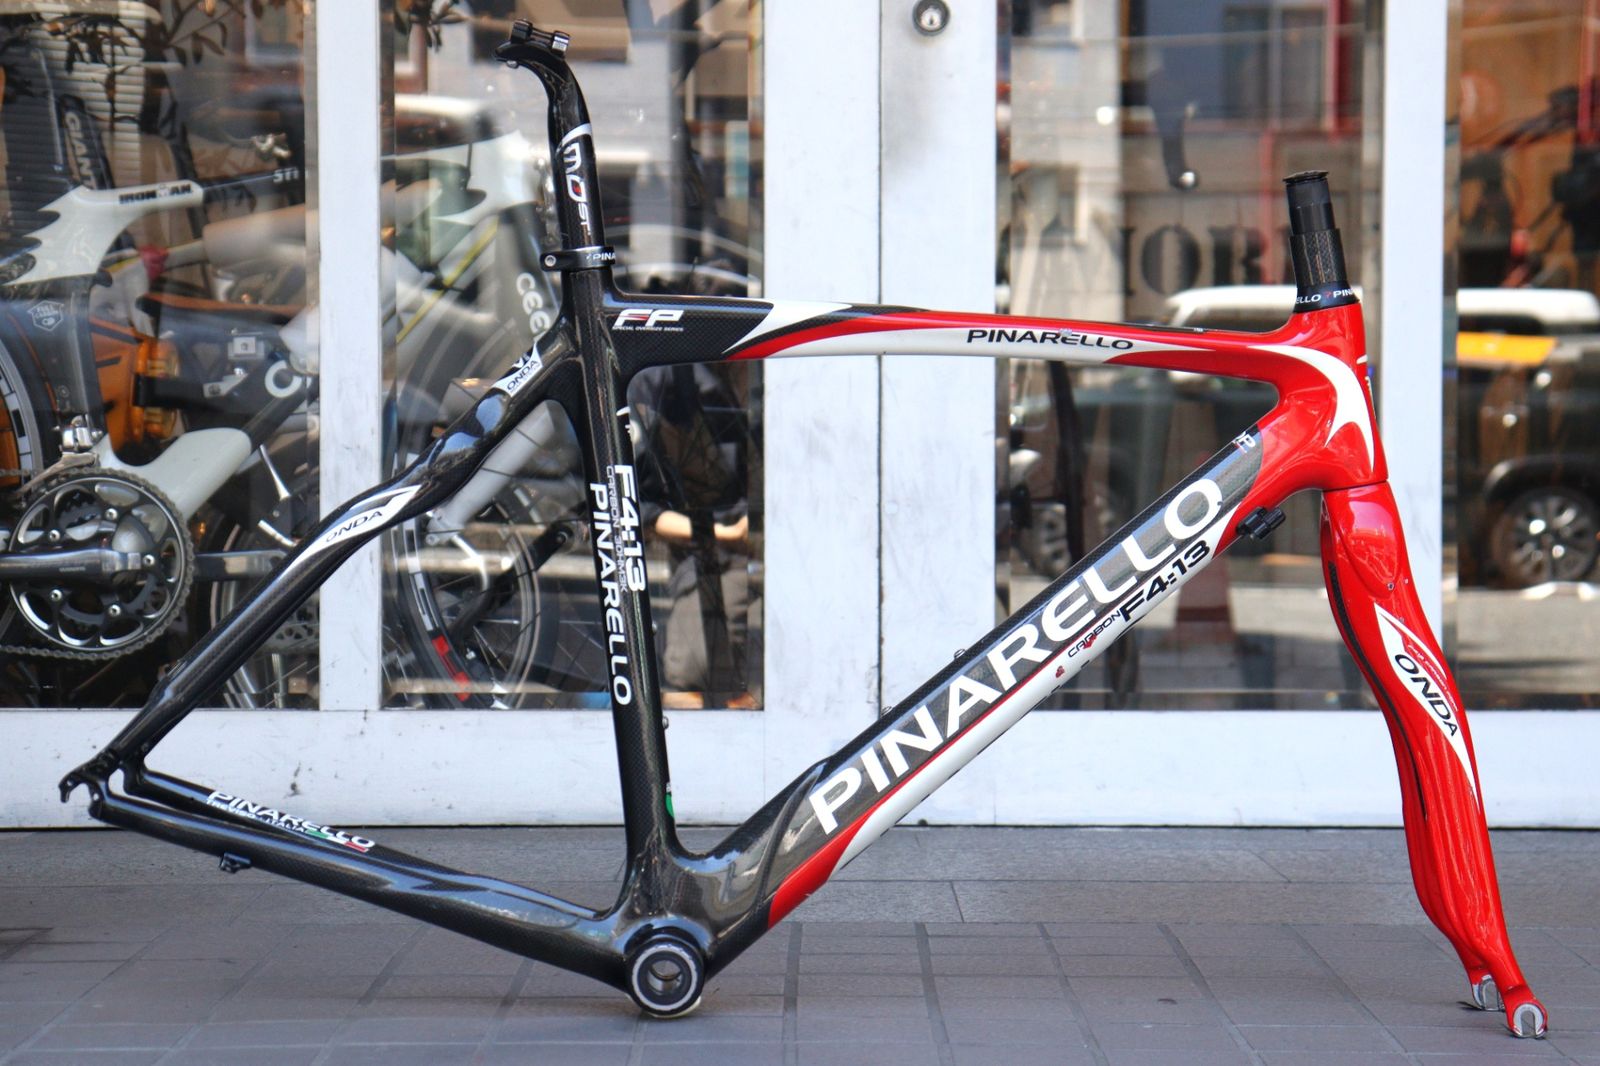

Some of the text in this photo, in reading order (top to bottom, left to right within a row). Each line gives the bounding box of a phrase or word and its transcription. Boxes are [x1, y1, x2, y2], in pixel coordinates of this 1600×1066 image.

[613, 308, 684, 327] FP
[967, 328, 1134, 351] PINARELLO
[506, 359, 539, 391] ONDA
[326, 510, 383, 543] ONDA
[606, 465, 620, 528] CARBON
[614, 464, 646, 592] F4:13
[590, 482, 633, 706] PINARELLO
[1067, 539, 1210, 658] CARBON F4:13
[808, 477, 1223, 836] PINARELLO
[1394, 653, 1458, 737] ONDA
[206, 790, 376, 848] PINARELLO
